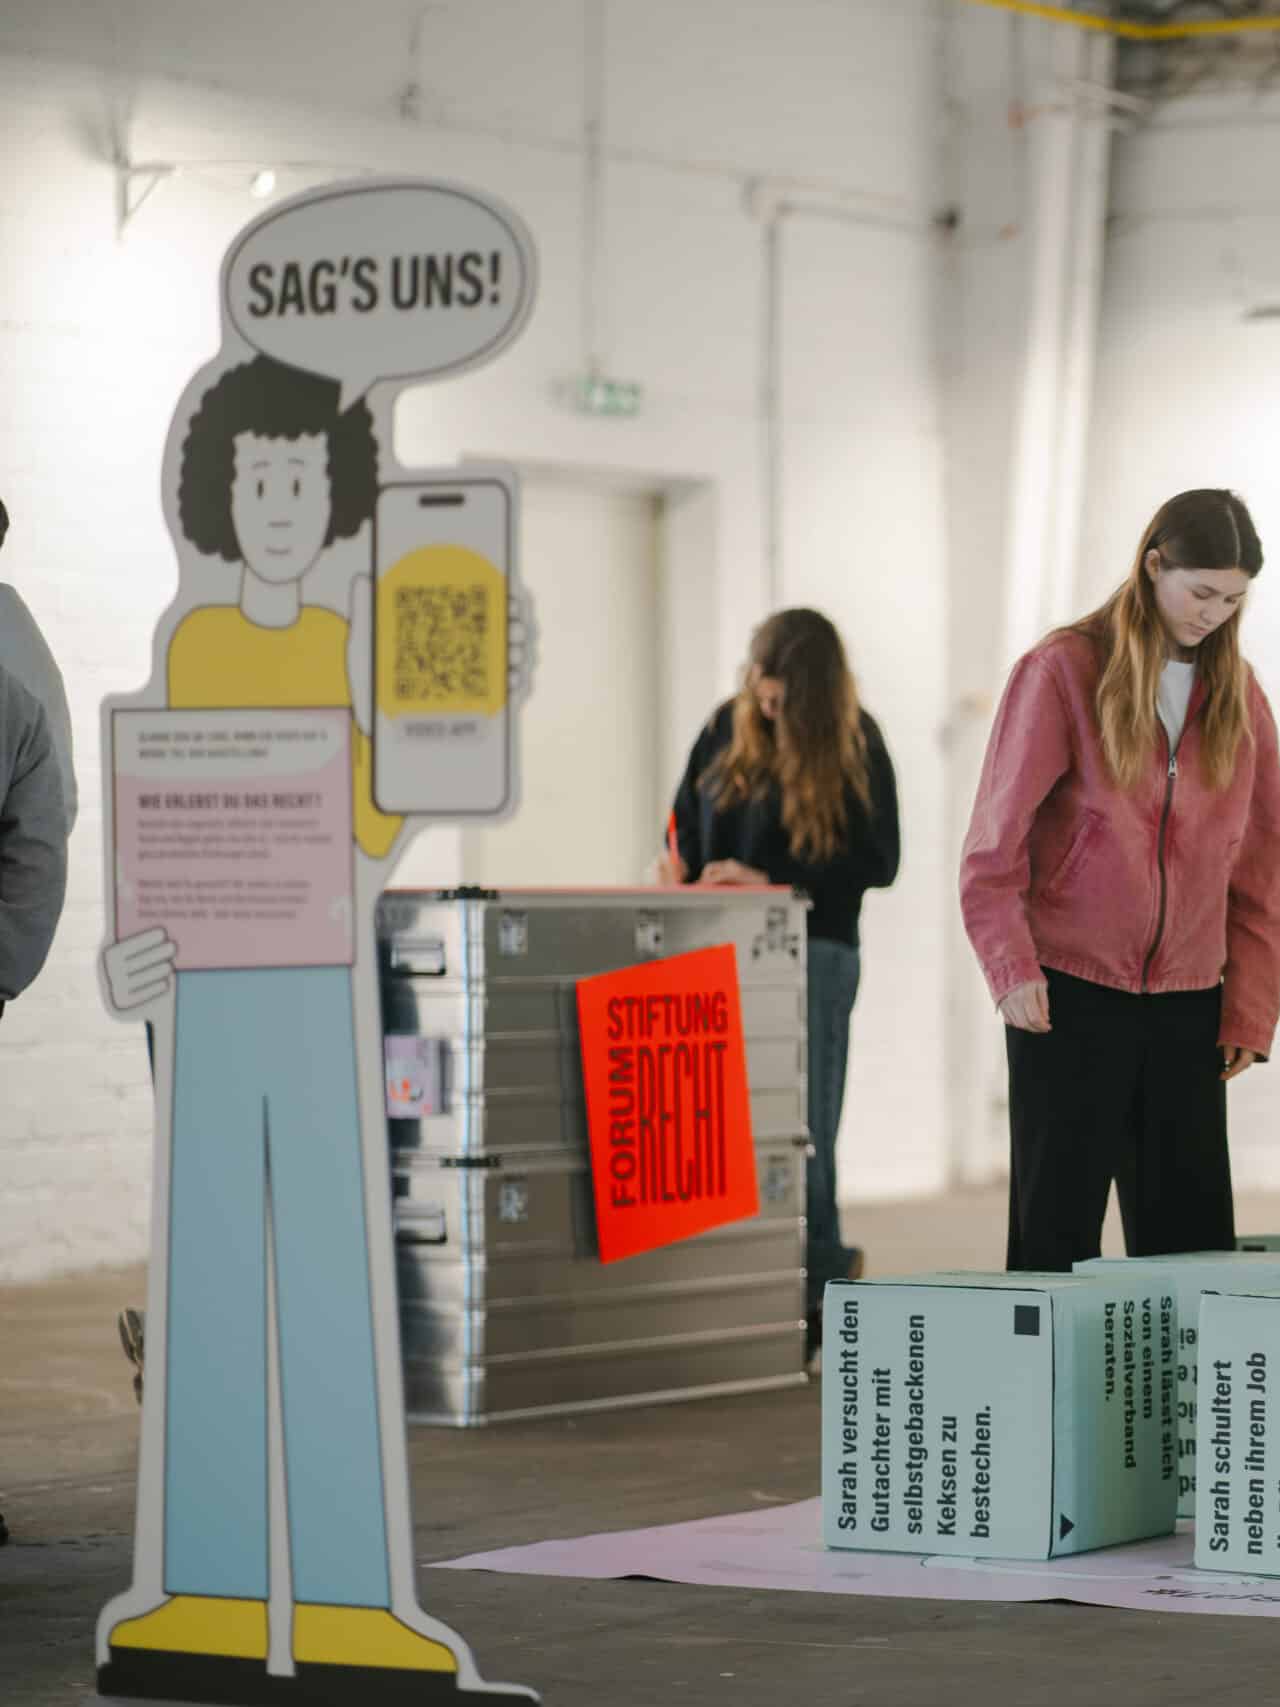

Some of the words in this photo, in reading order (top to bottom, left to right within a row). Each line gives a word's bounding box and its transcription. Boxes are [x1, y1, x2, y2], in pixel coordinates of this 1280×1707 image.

[248, 259, 378, 318] SAG'S
[393, 251, 502, 310] UNS!
[607, 992, 727, 1039] STIFTUNG
[608, 1047, 636, 1209] FORUM
[638, 1041, 727, 1205] RECHT
[838, 1300, 859, 1345] den
[1104, 1303, 1116, 1401] beraten.
[1142, 1298, 1152, 1340] von
[1161, 1296, 1173, 1364] Sarah
[838, 1348, 859, 1456] versucht
[870, 1368, 891, 1411] mit
[1123, 1301, 1137, 1468] Sozialverband
[1142, 1347, 1154, 1419] einem
[1161, 1370, 1173, 1427] lässt
[1245, 1352, 1268, 1394] Job
[903, 1314, 929, 1535] selbstgebackenen
[938, 1415, 958, 1441] zu
[1210, 1359, 1233, 1468] schultert
[1244, 1399, 1267, 1484] ihrem
[870, 1416, 891, 1533] Gutachter
[970, 1404, 992, 1538] bestechen.
[1161, 1430, 1174, 1481] sich
[838, 1461, 858, 1531] Sarah
[936, 1449, 958, 1536] Keksen
[1209, 1469, 1231, 1553] Sarah
[1243, 1487, 1265, 1555] neben
